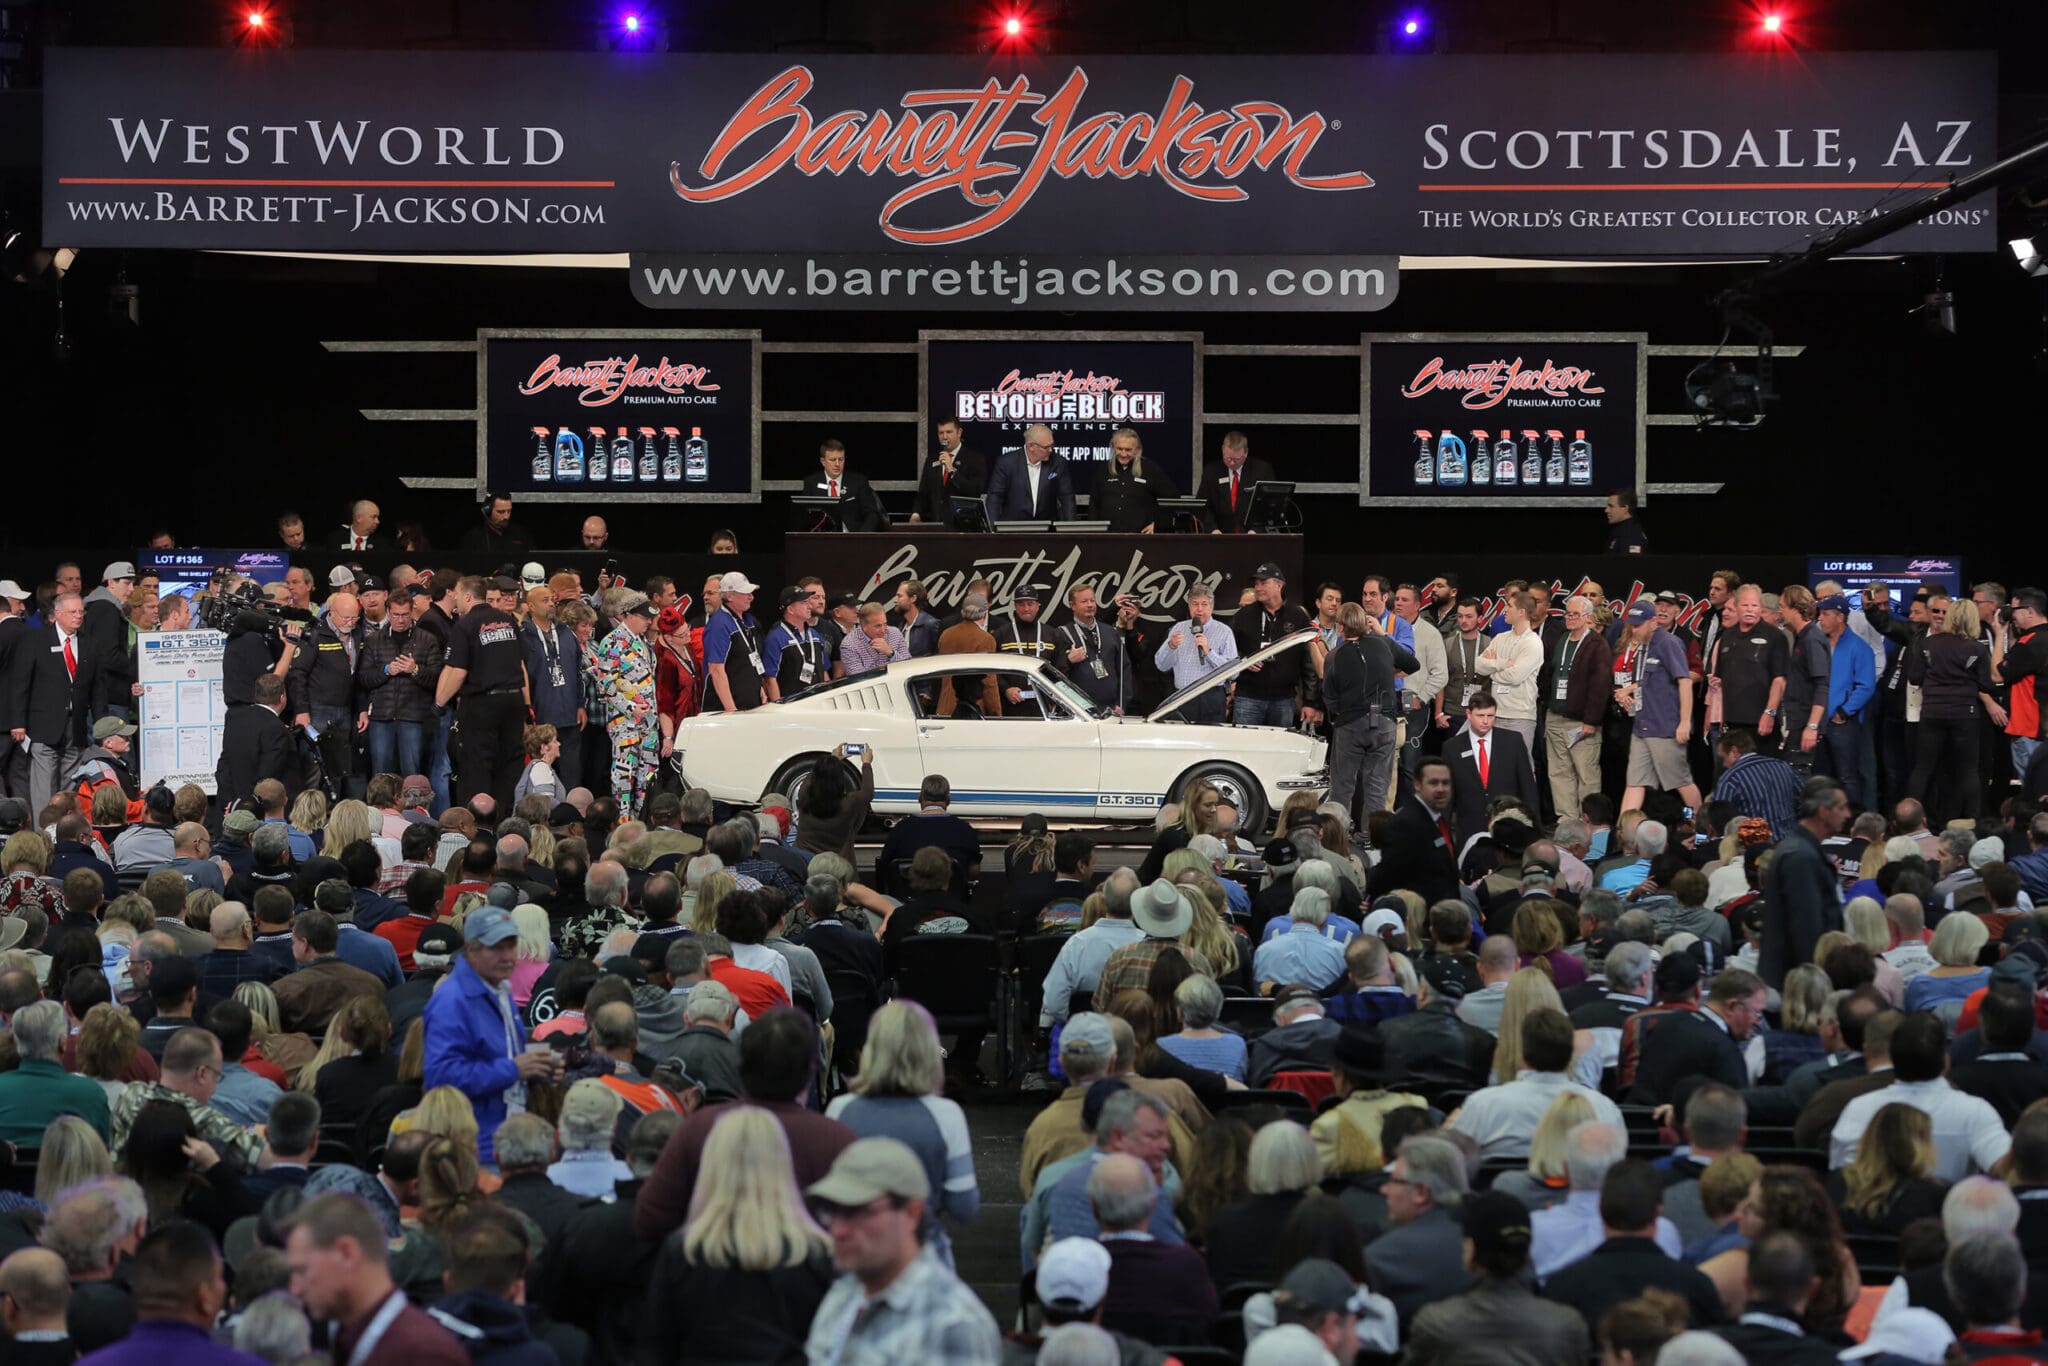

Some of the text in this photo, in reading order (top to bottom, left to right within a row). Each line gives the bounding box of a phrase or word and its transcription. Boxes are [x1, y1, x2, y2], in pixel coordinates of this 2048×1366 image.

[670, 65, 1376, 246] Barrett-Jackson
[1422, 120, 1972, 174] SCOTTSDALE, AZ
[643, 259, 1387, 305] www.barrett-jackson.com
[518, 353, 721, 407] Barrett-Jackson
[1401, 356, 1606, 410] Barrett-Jackson
[957, 391, 1061, 421] BEYOND
[1077, 391, 1164, 421] BLOCK
[1001, 423, 1119, 431] EXPRIENCE
[1072, 446, 1091, 461] APP
[155, 555, 203, 564] LOT #1365
[1824, 562, 1873, 571] LOT #1365
[189, 638, 220, 648] 350
[1124, 796, 1155, 805] 350
